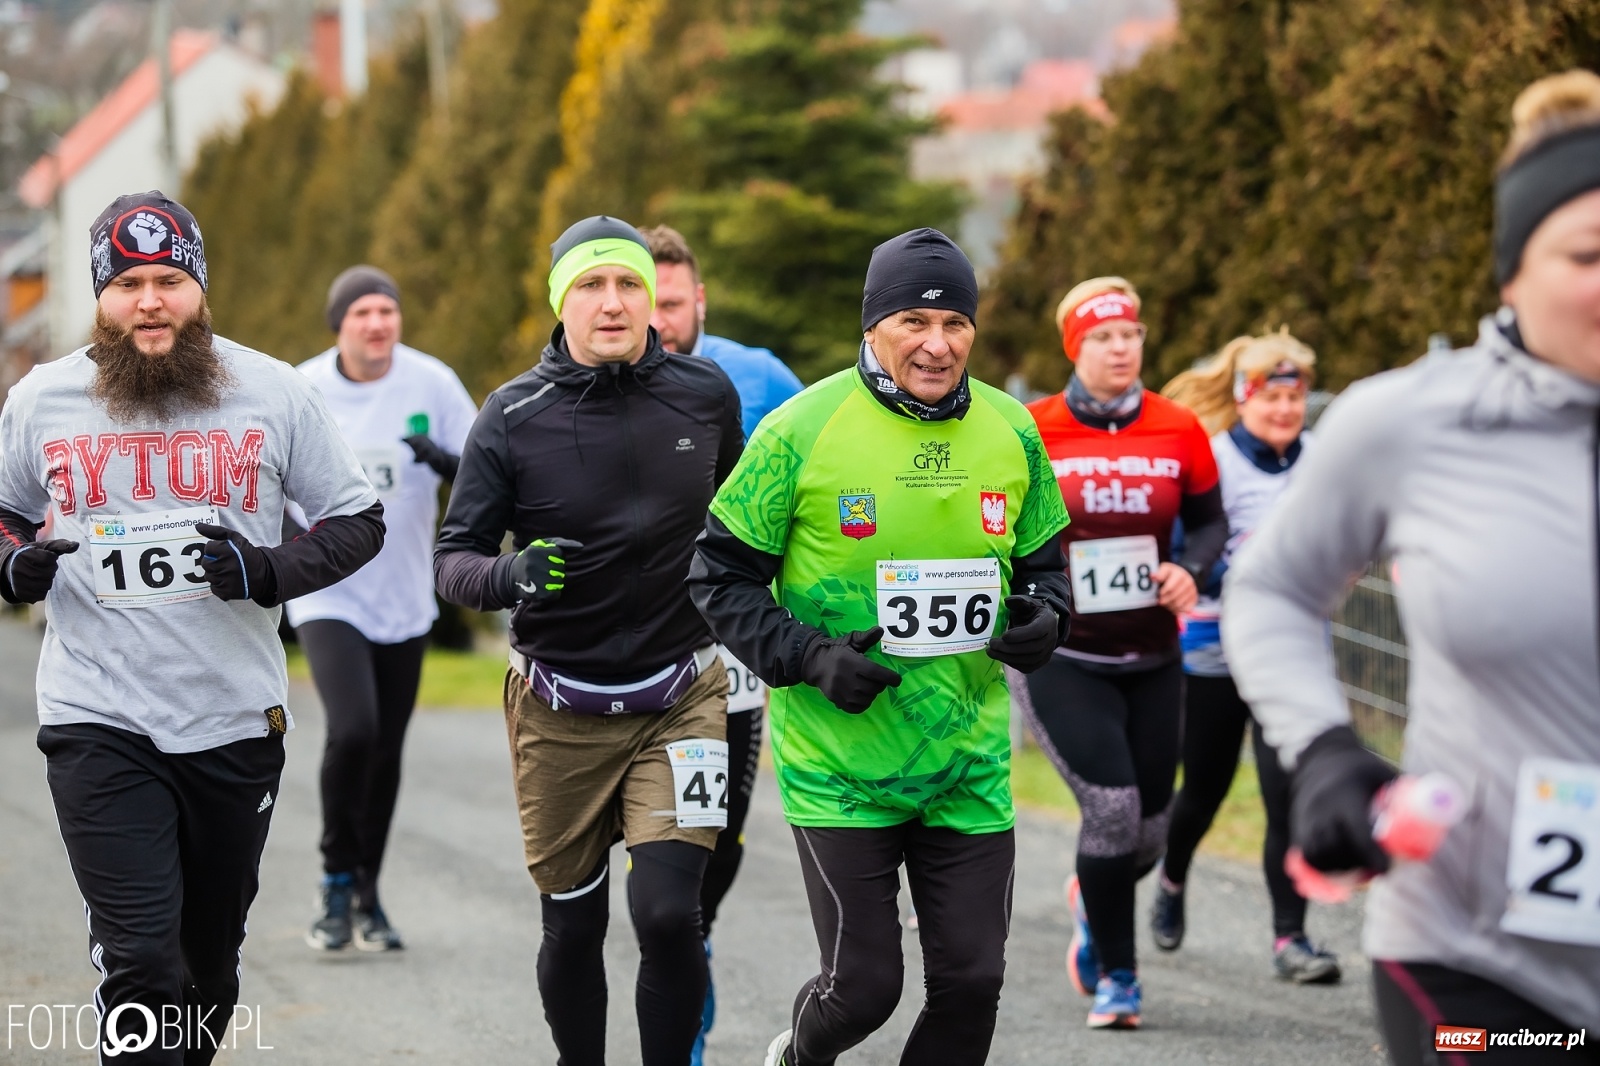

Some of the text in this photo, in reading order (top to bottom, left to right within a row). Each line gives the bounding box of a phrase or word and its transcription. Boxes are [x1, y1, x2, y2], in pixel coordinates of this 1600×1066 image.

[172, 233, 197, 256] FIGHT
[922, 289, 943, 299] 4F
[43, 429, 264, 516] BYTOM
[913, 451, 950, 473] Gryf
[102, 543, 209, 590] 163
[925, 569, 996, 579] www.personalbest.pl
[1081, 564, 1152, 595] 148
[886, 593, 992, 639] 356
[683, 771, 728, 810] 42
